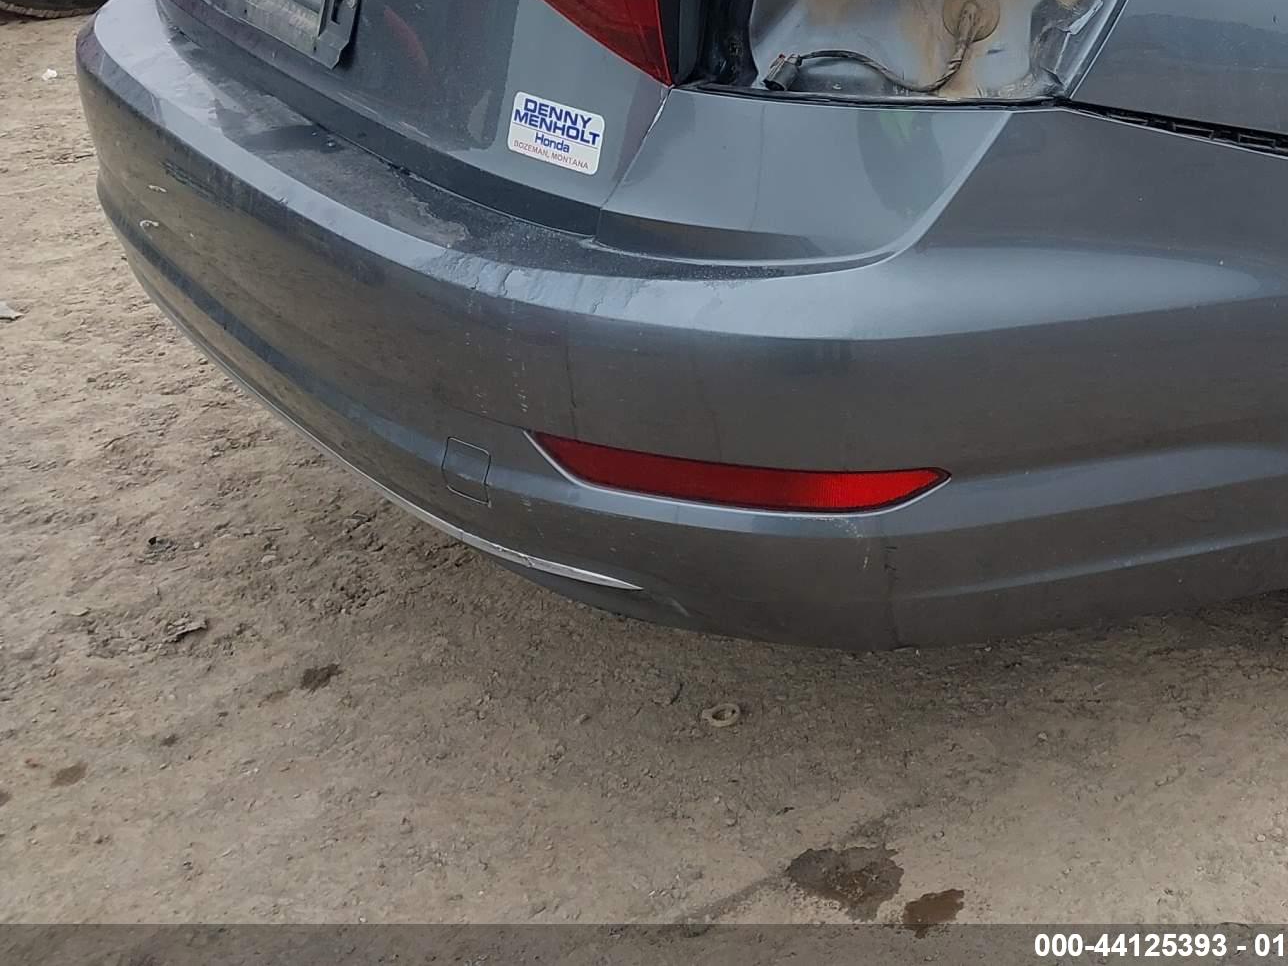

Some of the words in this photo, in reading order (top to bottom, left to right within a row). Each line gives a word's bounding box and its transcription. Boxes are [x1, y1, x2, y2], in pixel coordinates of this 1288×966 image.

[513, 109, 600, 145] MENHOLT
[524, 98, 592, 129] DENNY
[514, 139, 550, 158] BOZEMAN,
[551, 152, 589, 170] MONTANA
[535, 132, 570, 153] Honda
